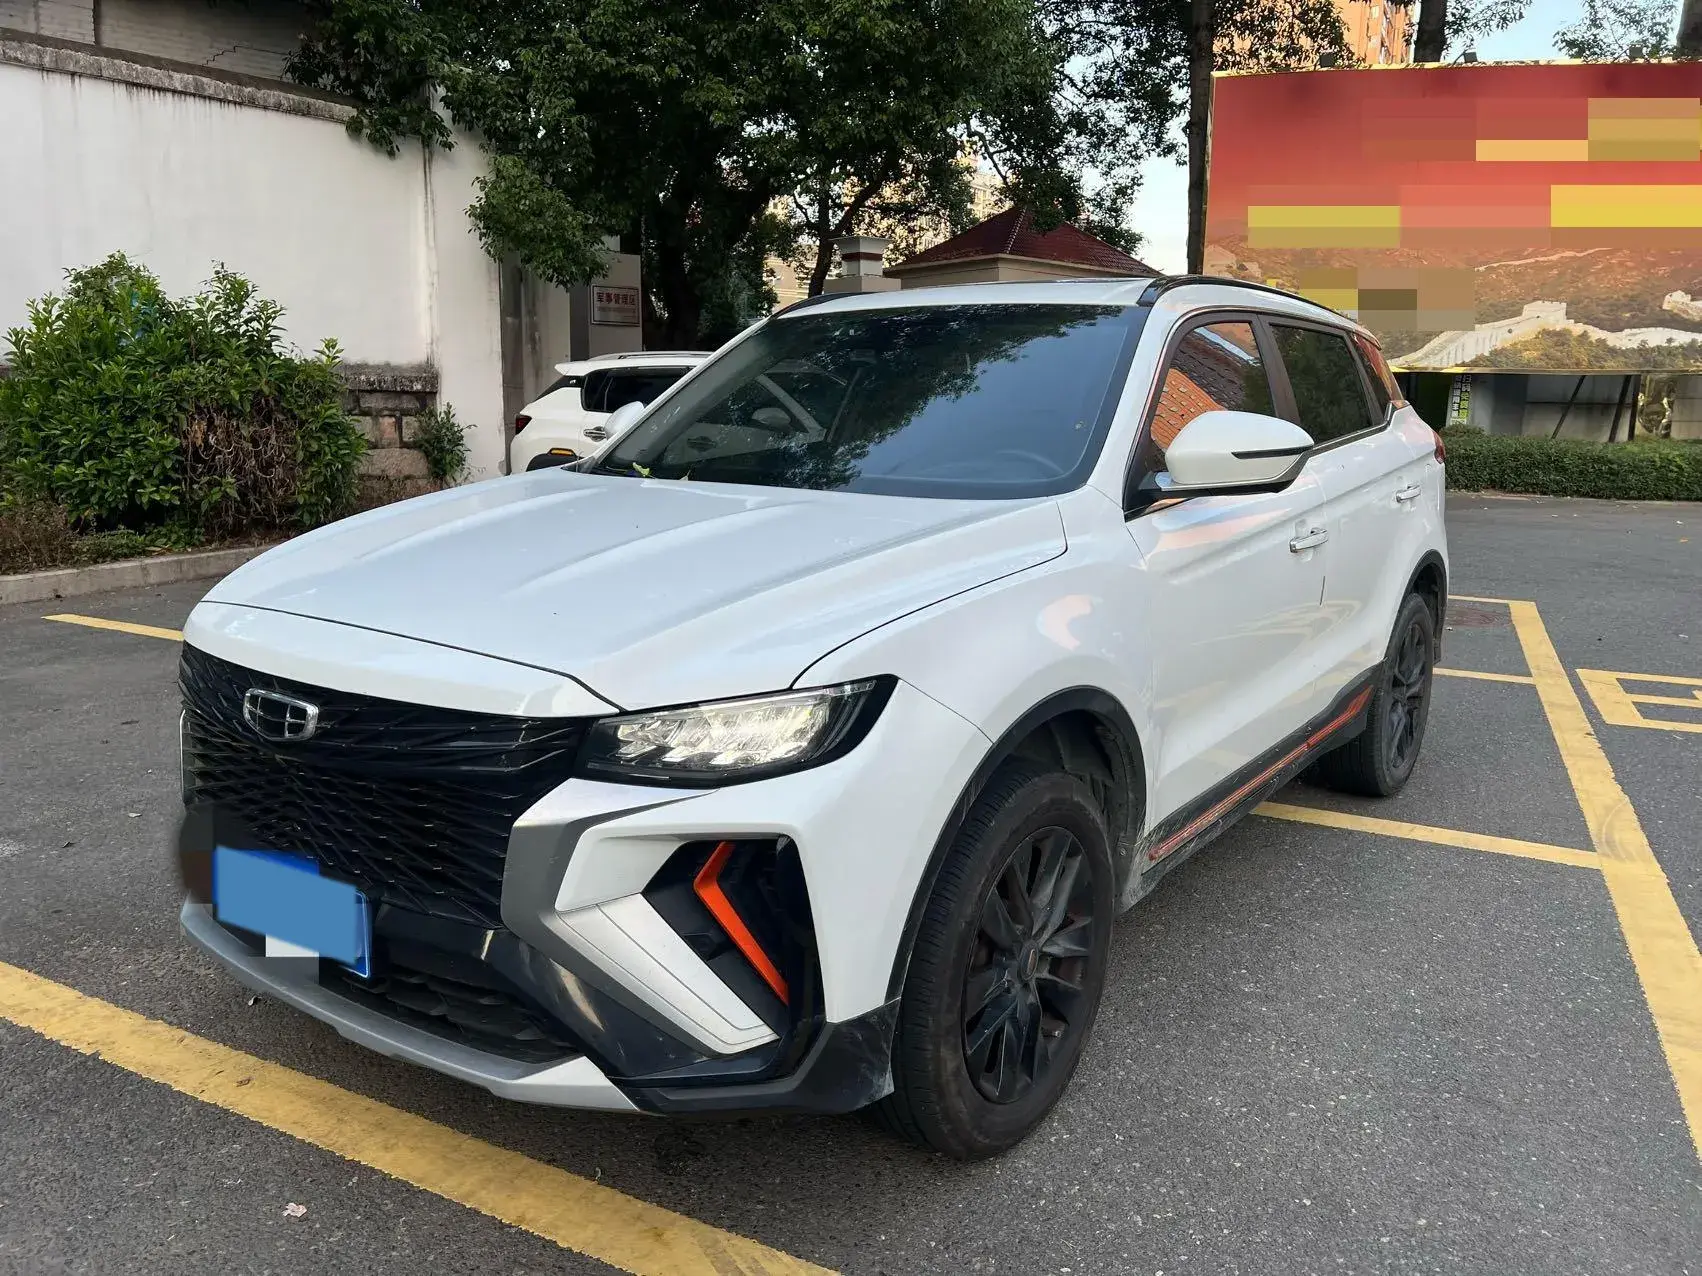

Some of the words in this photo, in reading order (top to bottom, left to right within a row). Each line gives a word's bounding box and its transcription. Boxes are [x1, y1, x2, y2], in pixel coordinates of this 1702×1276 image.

[597, 293, 636, 305] 军事管理区
